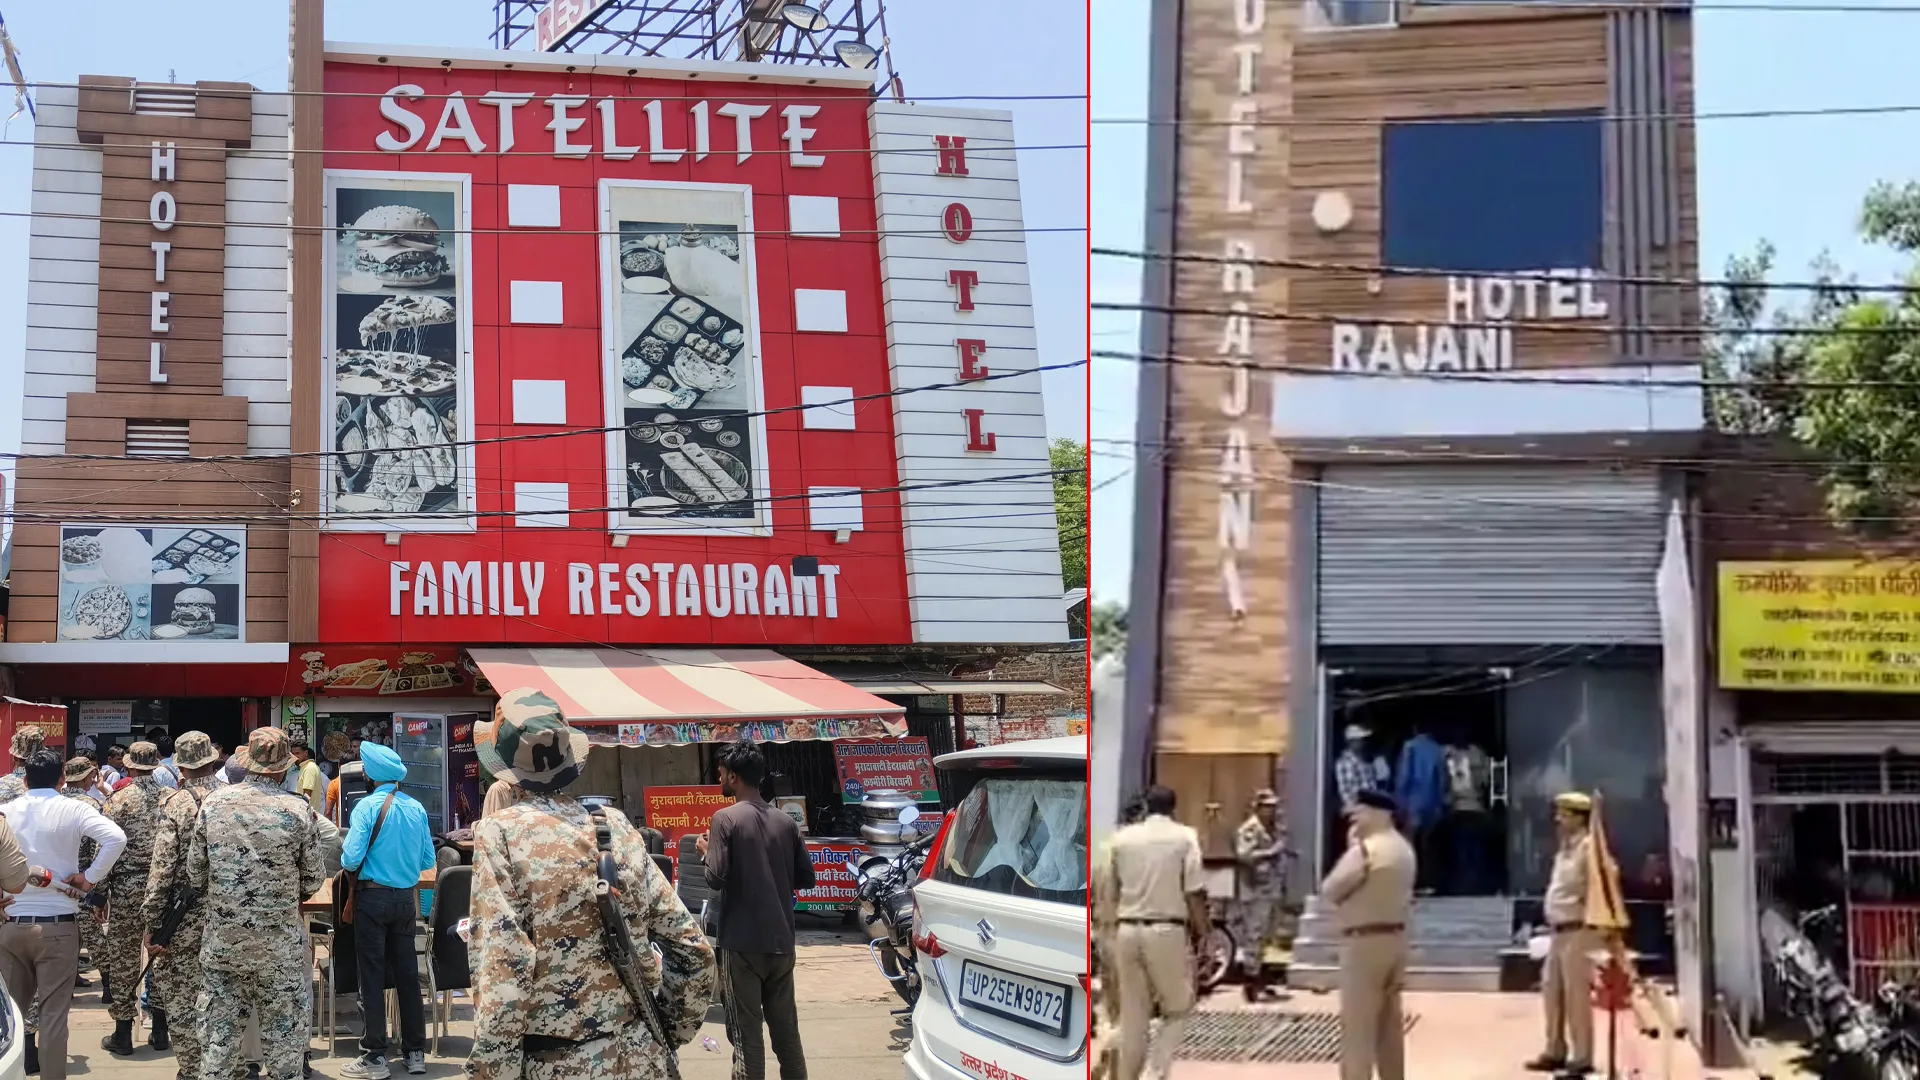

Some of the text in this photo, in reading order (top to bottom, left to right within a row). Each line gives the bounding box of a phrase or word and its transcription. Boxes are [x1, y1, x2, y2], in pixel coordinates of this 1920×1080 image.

[538, 0, 597, 52] RES
[375, 84, 826, 168] SATELLITE
[149, 140, 177, 384] HOTEL
[932, 134, 997, 453] HOTEL
[1447, 268, 1608, 322] HOTEL
[1331, 324, 1514, 373] RAJANI
[1217, 240, 1256, 618] RAJANI
[390, 560, 841, 619] FAMILY RESTAURANT
[408, 721, 428, 732] CAMPA
[454, 724, 471, 737] CAMPA
[652, 813, 689, 828] बिरयानी
[972, 971, 1063, 1022] UP25EN9872
[960, 1051, 982, 1074] उत्तर
